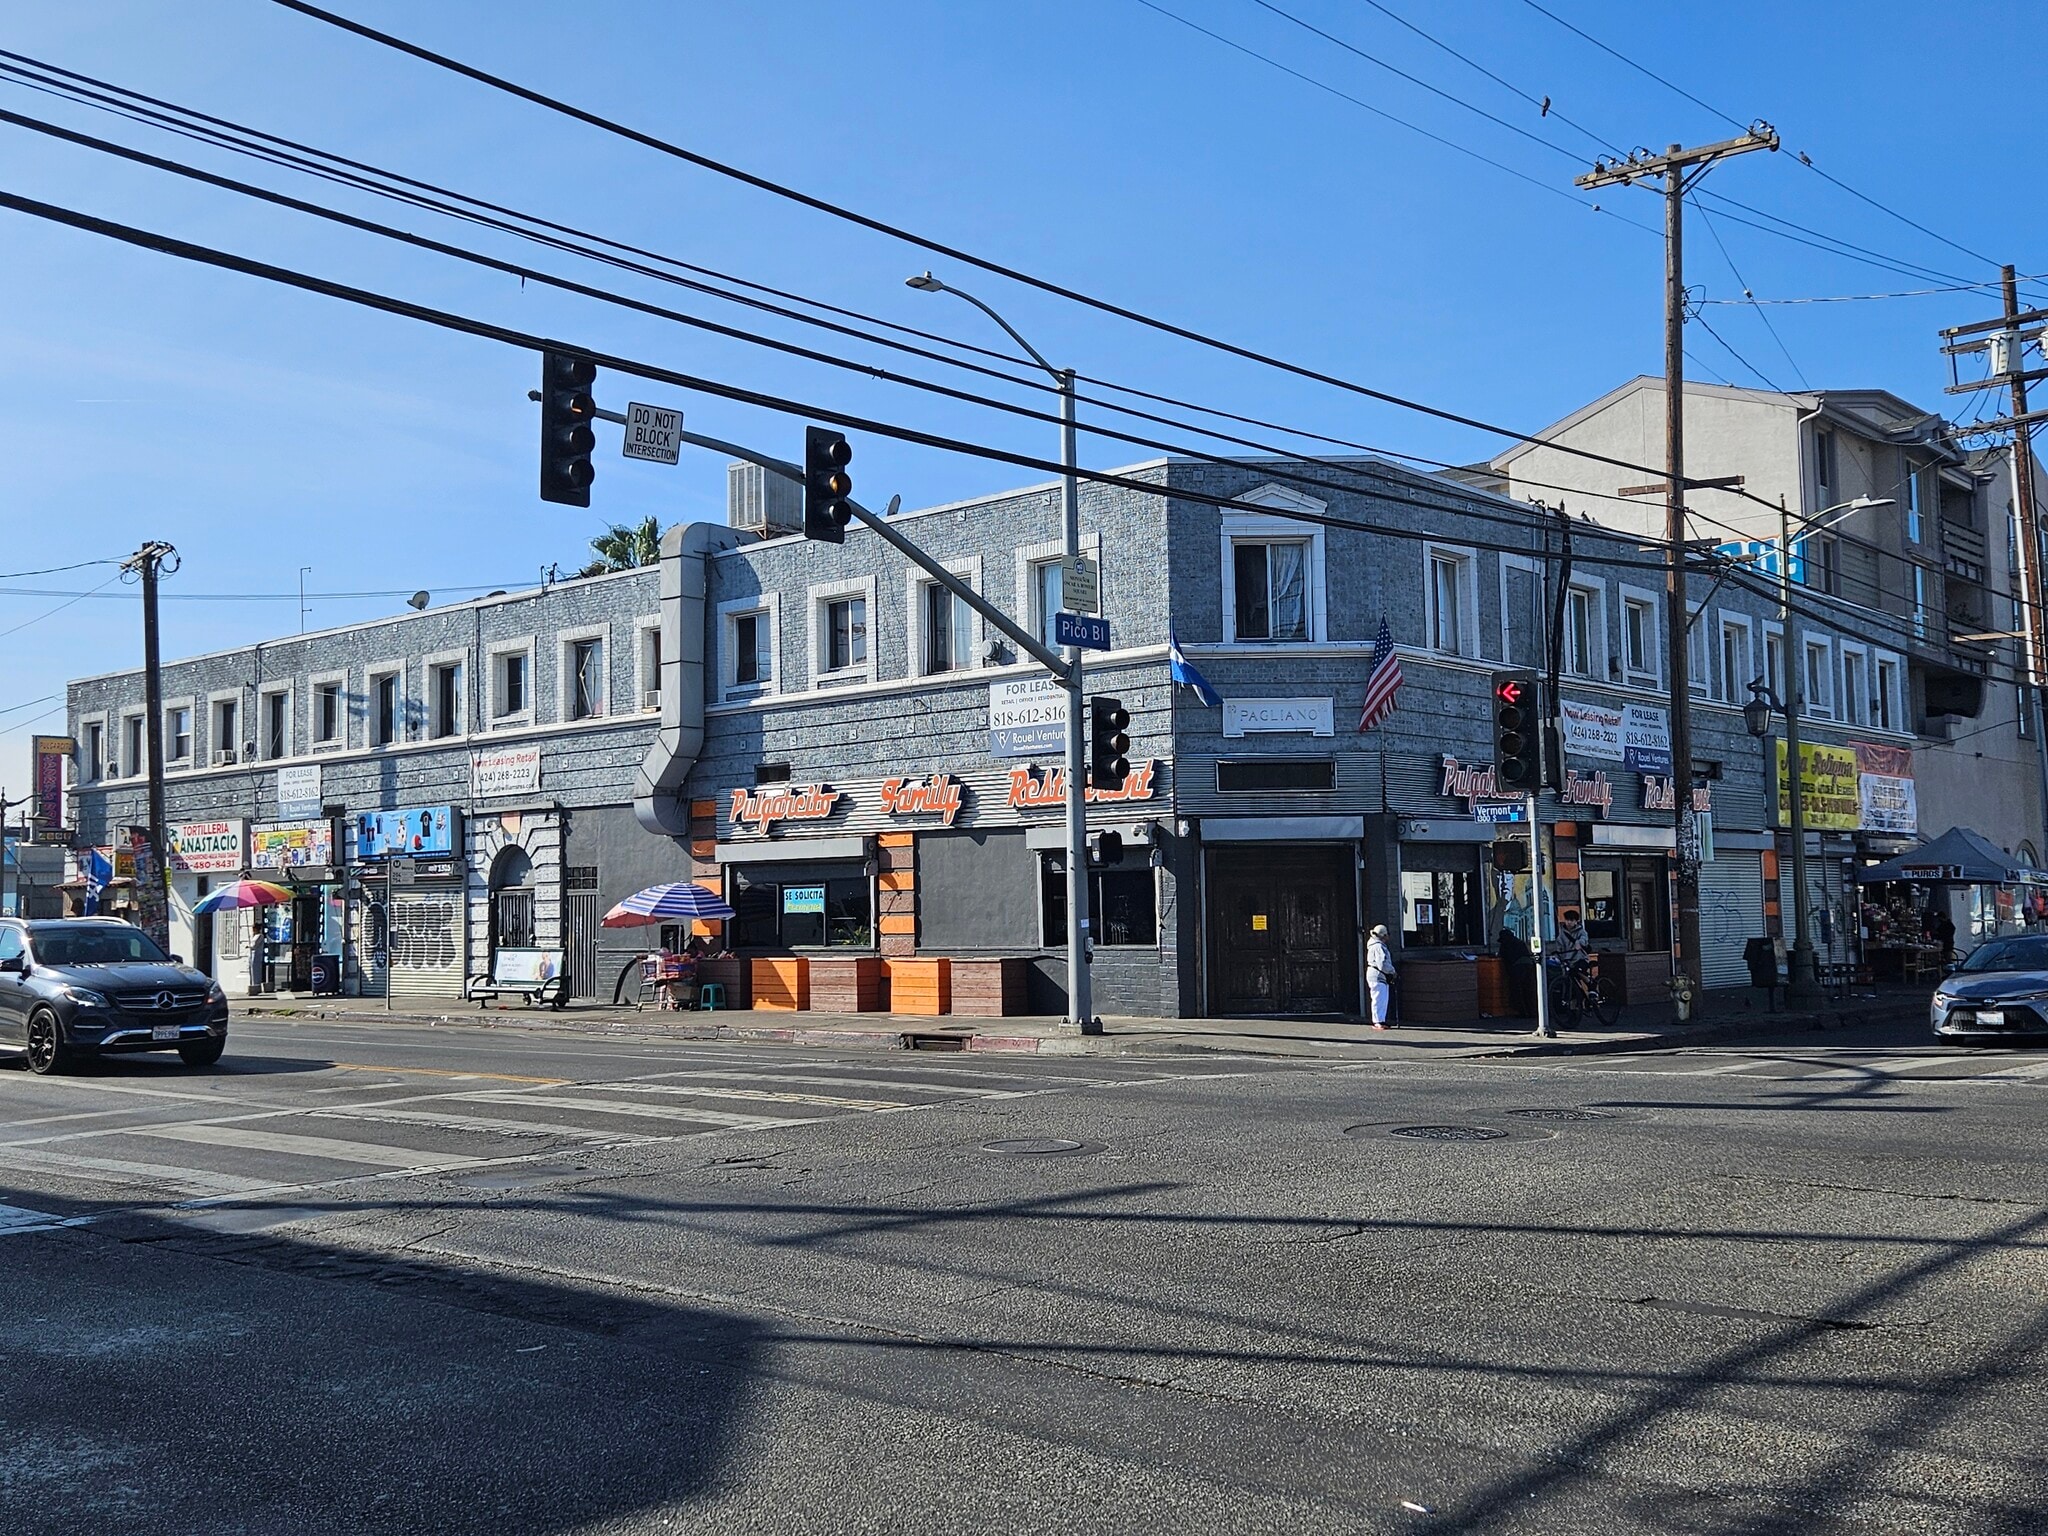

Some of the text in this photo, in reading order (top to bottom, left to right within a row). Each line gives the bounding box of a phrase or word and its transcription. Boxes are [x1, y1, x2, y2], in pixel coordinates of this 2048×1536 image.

[634, 408, 676, 429] DO NOT
[635, 427, 670, 447] BLOCK
[626, 443, 676, 460] INTERSECTION
[1062, 621, 1104, 641] Pico Bl
[1006, 683, 1026, 695] FOR
[993, 705, 1066, 726] 818-612-816
[1240, 709, 1318, 721] PAGLIANO
[1580, 709, 1603, 726] Leasing
[1631, 709, 1659, 721] FOR LEASE
[1012, 730, 1035, 744] Rouel
[1571, 724, 1617, 743] (424) 268-2223
[1626, 731, 1668, 748] 818-612-8162
[286, 768, 312, 779] FOR LEASE
[498, 768, 530, 780] 268-2223
[1442, 757, 1524, 814] Pulgar
[1562, 769, 1613, 819] Family
[729, 759, 1155, 835] Pulgarcito Family Restnt
[1477, 805, 1511, 816] Vermont
[183, 823, 229, 836] TORTILLERIA
[180, 835, 237, 853] ANASTACIO
[176, 860, 235, 870] 213-480-8431
[785, 890, 824, 900] SE SOLICITA
